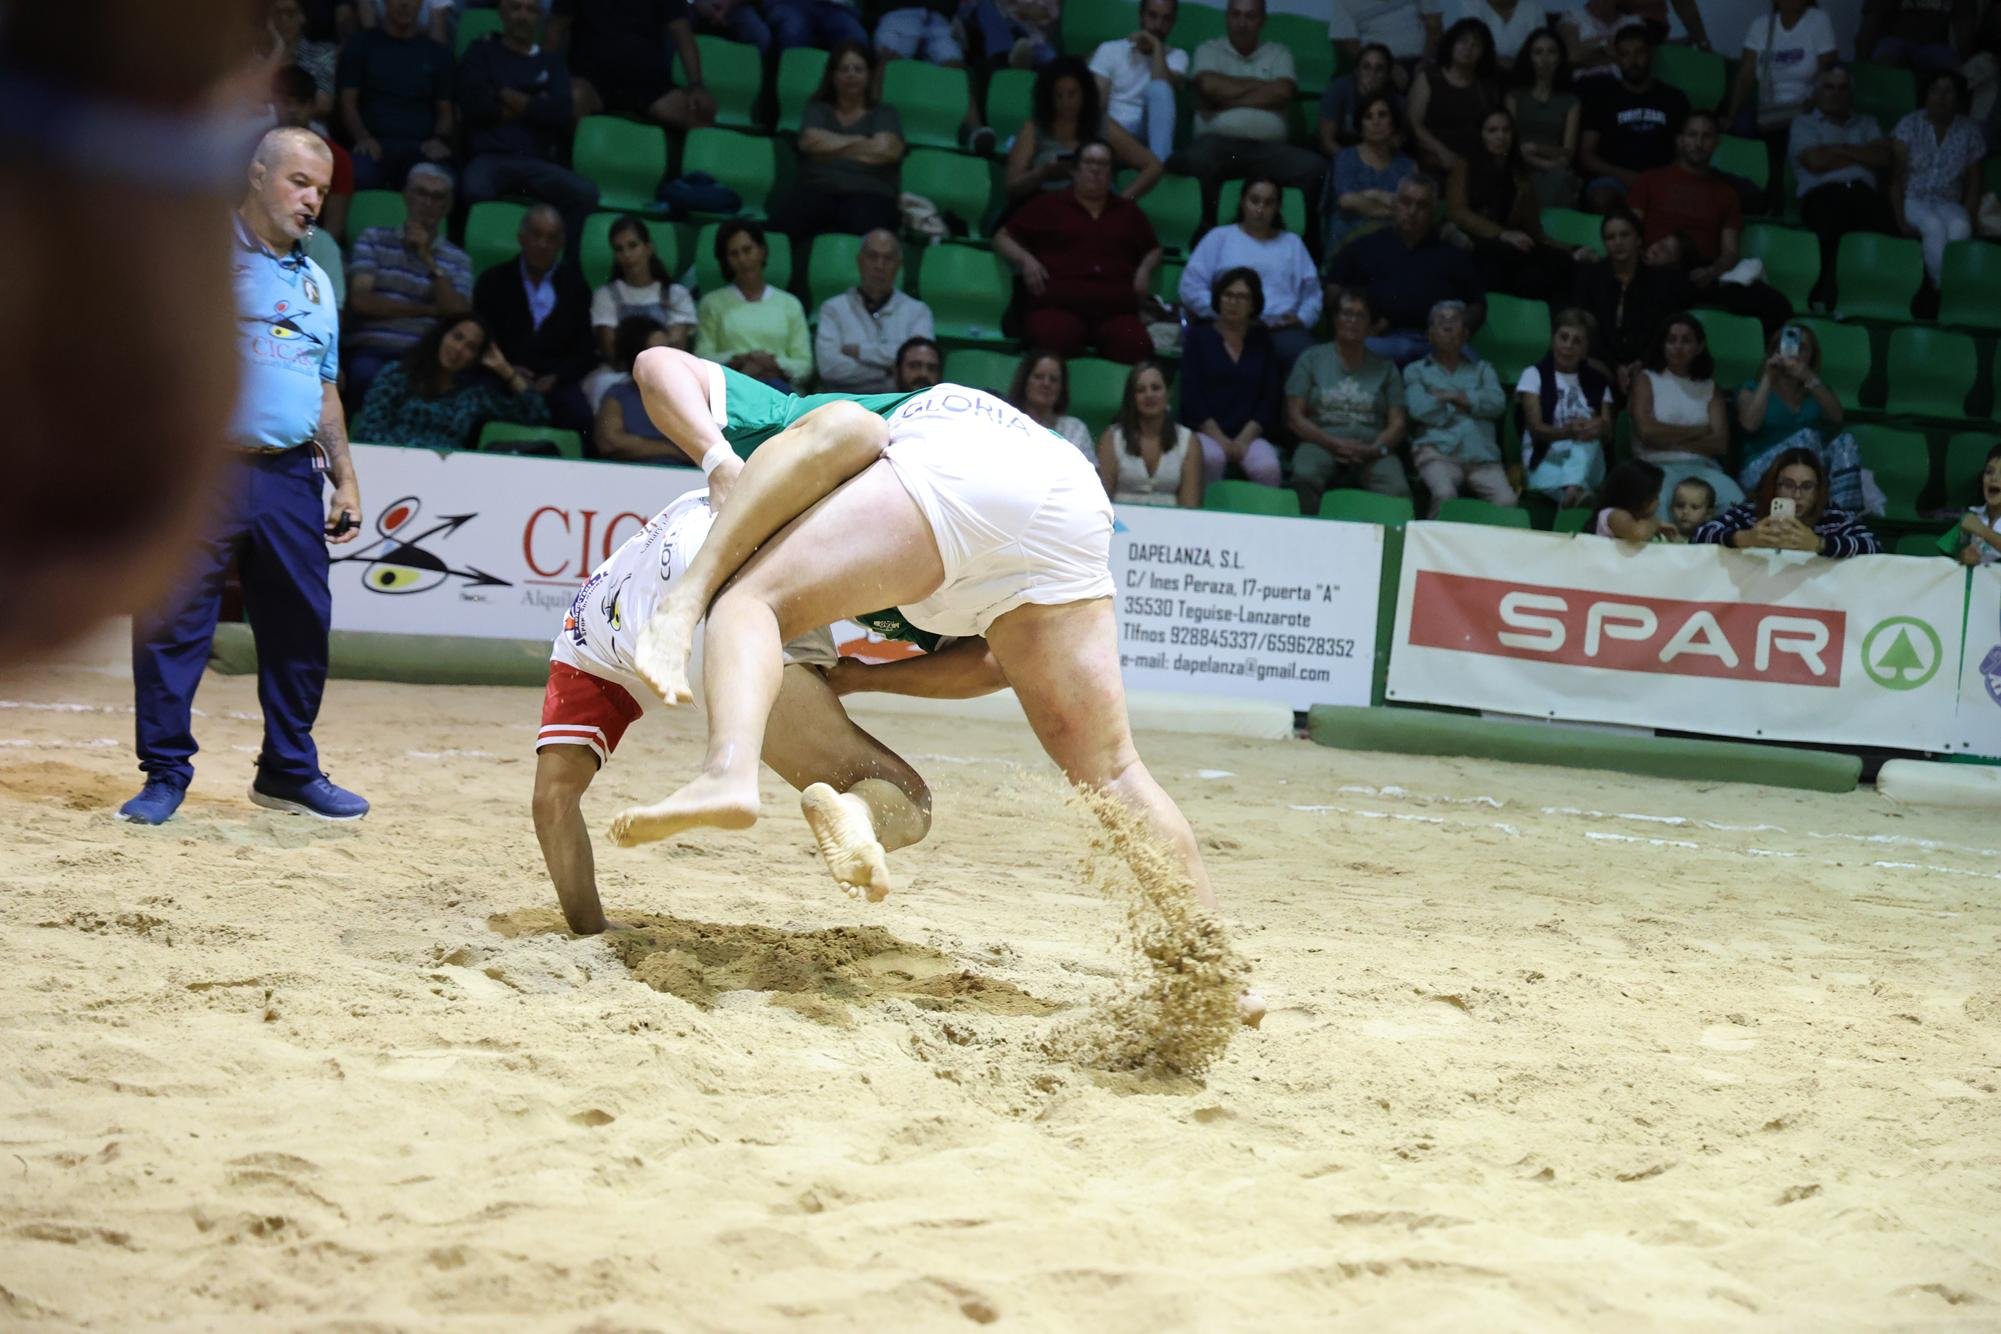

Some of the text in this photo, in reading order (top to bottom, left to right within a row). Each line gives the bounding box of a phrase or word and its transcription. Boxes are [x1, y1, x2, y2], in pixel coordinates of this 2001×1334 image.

[902, 394, 1031, 437] GLORIA
[1128, 542, 1245, 569] DAPELANZA, S.L.
[1149, 571, 1180, 591] Ines
[1183, 573, 1238, 597] Peraza,
[1242, 578, 1312, 602] 17-puerta
[1316, 583, 1341, 602] "A"
[1124, 596, 1174, 617] 35530
[1123, 622, 1356, 658] Tlfnos 928845337/659628352
[1498, 591, 1829, 676] SPAR
